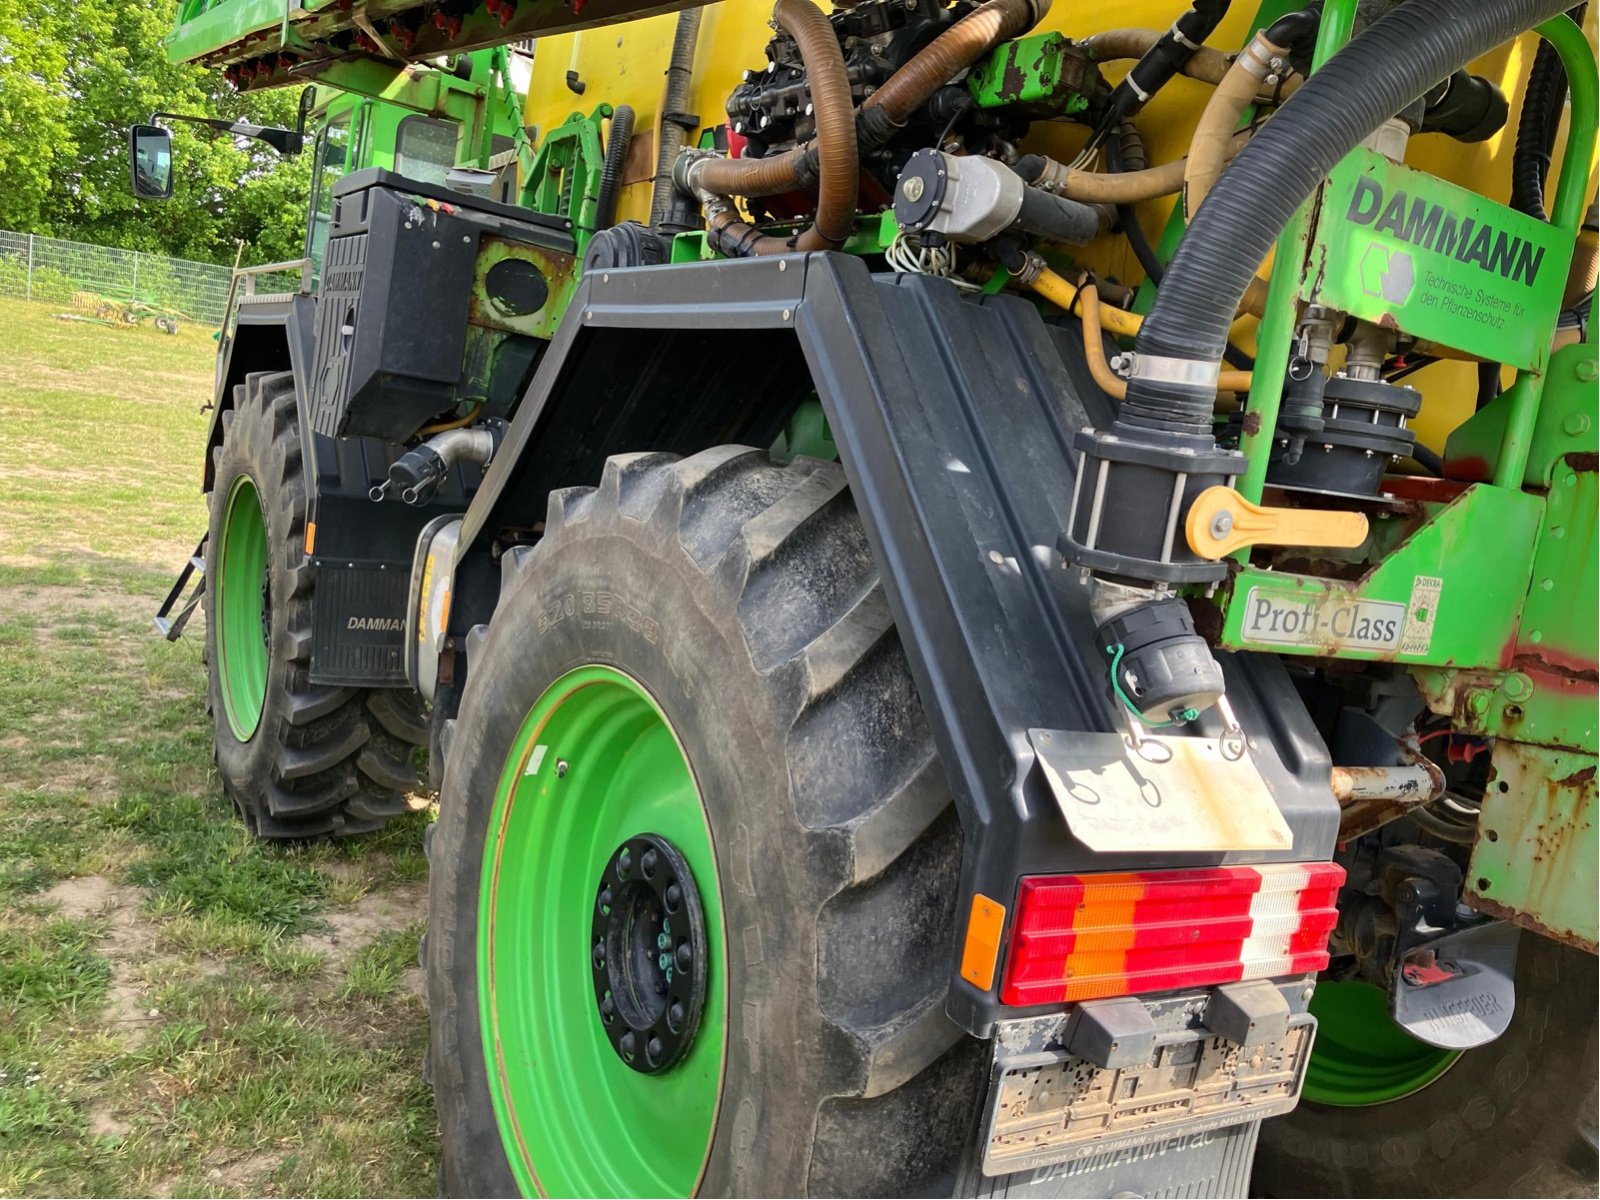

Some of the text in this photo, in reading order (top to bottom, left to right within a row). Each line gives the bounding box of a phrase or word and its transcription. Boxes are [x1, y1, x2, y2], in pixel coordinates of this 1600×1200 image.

[1346, 174, 1546, 288] DAMMANN
[1420, 291, 1505, 329] den Pflanzenschutz
[1425, 271, 1526, 318] Technische Systeme für
[1423, 578, 1441, 588] DEKRA
[1251, 598, 1397, 642] Profi-Class
